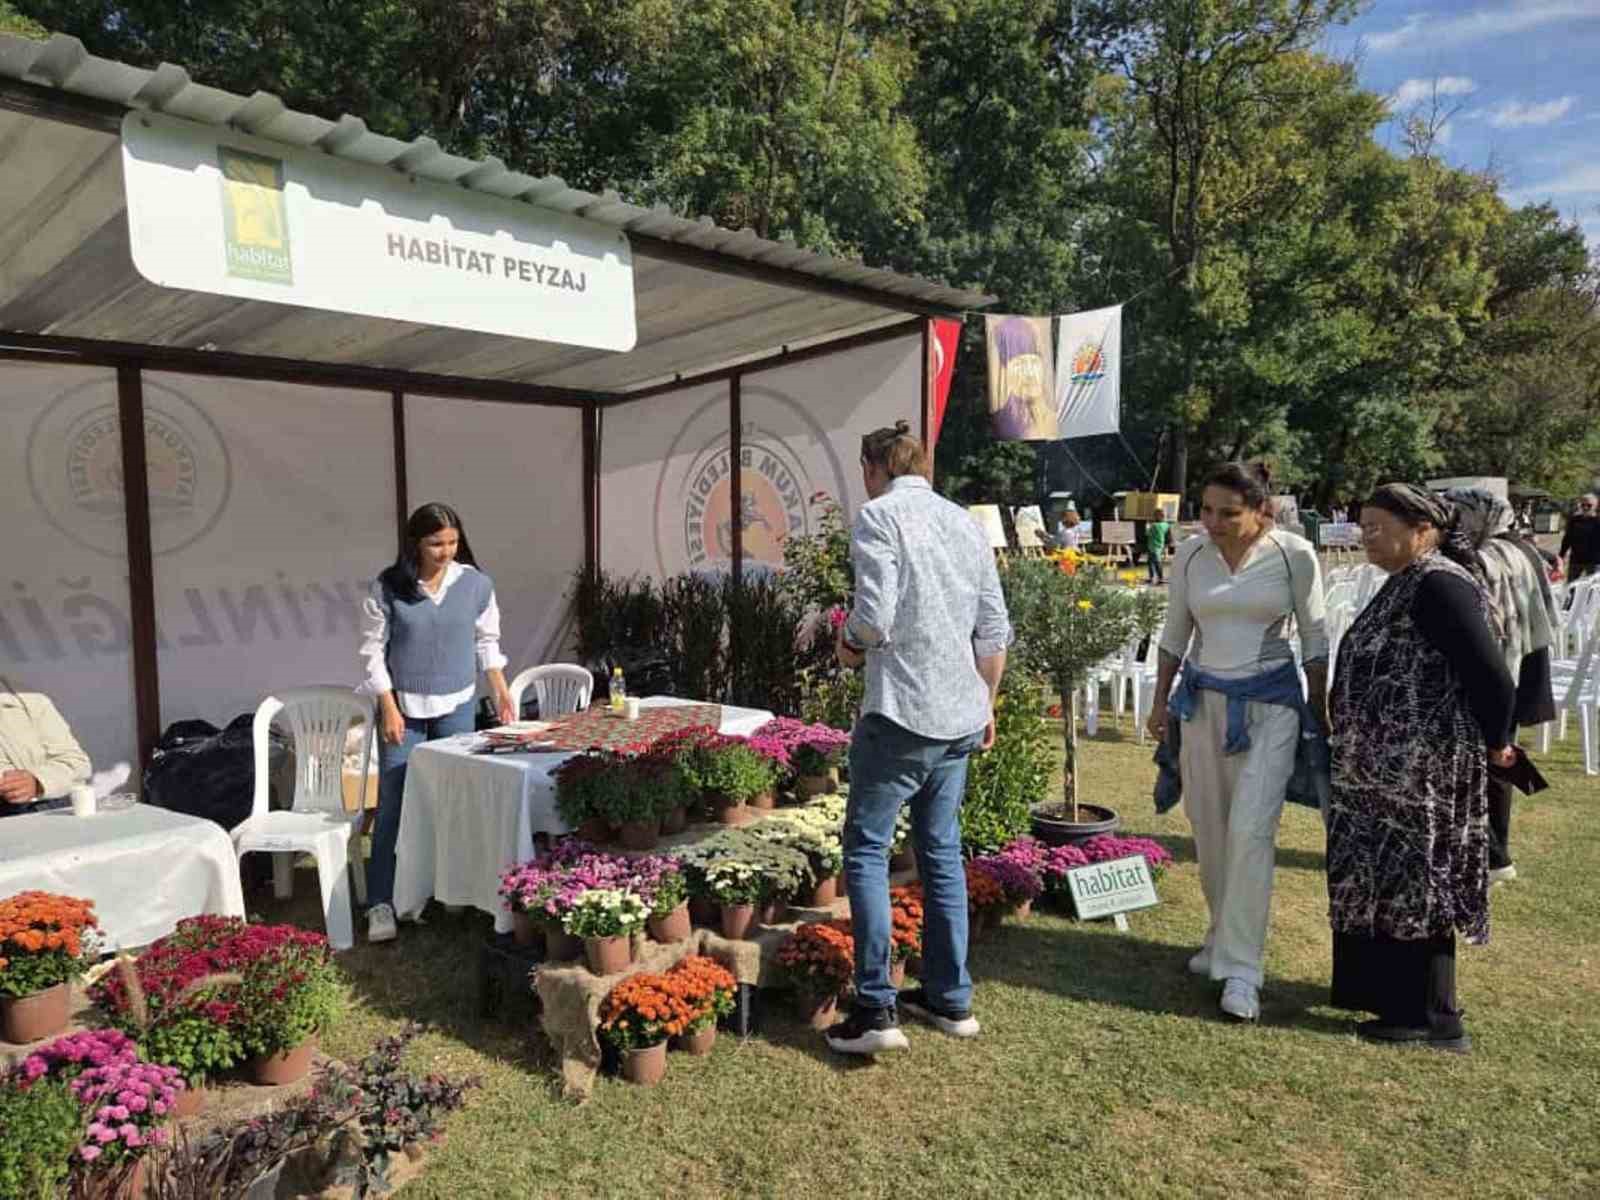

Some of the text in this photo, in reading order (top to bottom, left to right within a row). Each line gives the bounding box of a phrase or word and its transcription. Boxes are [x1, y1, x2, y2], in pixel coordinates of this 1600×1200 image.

[227, 241, 290, 269] habitat
[387, 234, 587, 292] HABİTAT PEYZAJ
[1074, 865, 1145, 897] habitat
